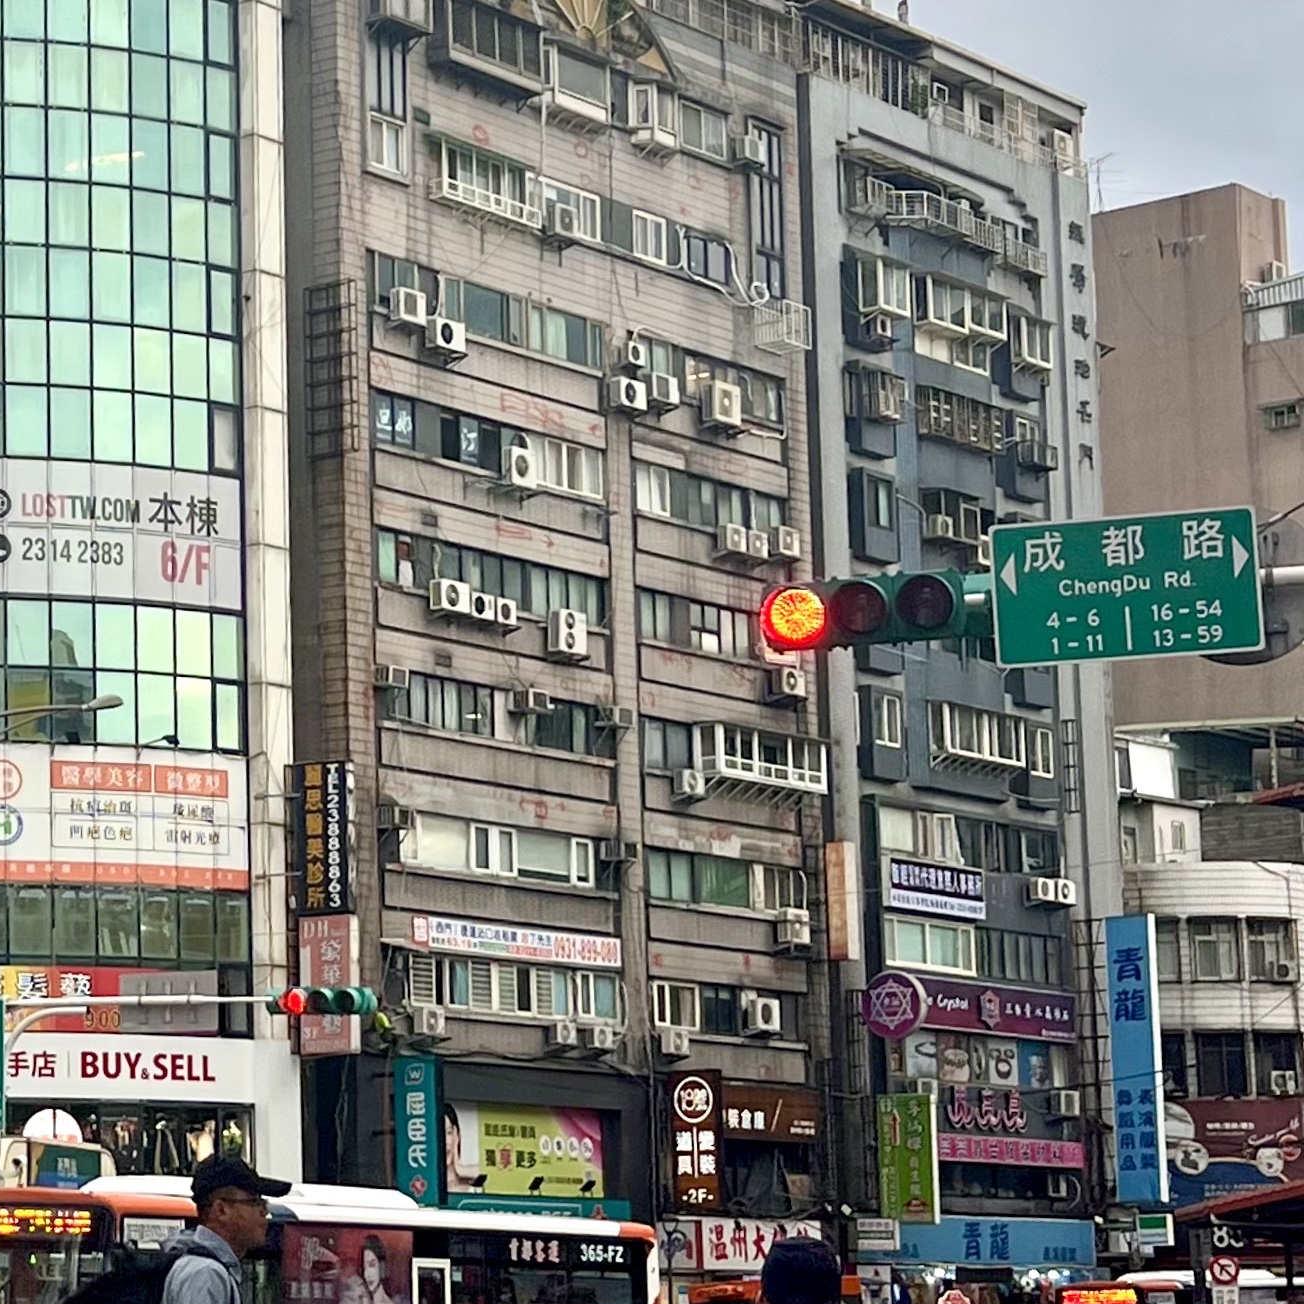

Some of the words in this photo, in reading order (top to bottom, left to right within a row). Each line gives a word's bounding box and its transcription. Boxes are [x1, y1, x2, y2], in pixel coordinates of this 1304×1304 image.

[21, 493, 140, 524] LOSTTW.COM
[148, 492, 219, 537] 本棟
[161, 540, 213, 586] 6/F
[1023, 518, 1226, 573] 成都路
[1059, 575, 1151, 598] ChengDu
[61, 765, 143, 788] 醫學美容
[1113, 946, 1148, 1022] 青龍
[722, 1108, 765, 1131] 裝倉庫
[580, 1244, 625, 1263] 365-FZ
[963, 1222, 1011, 1262] 青龍
